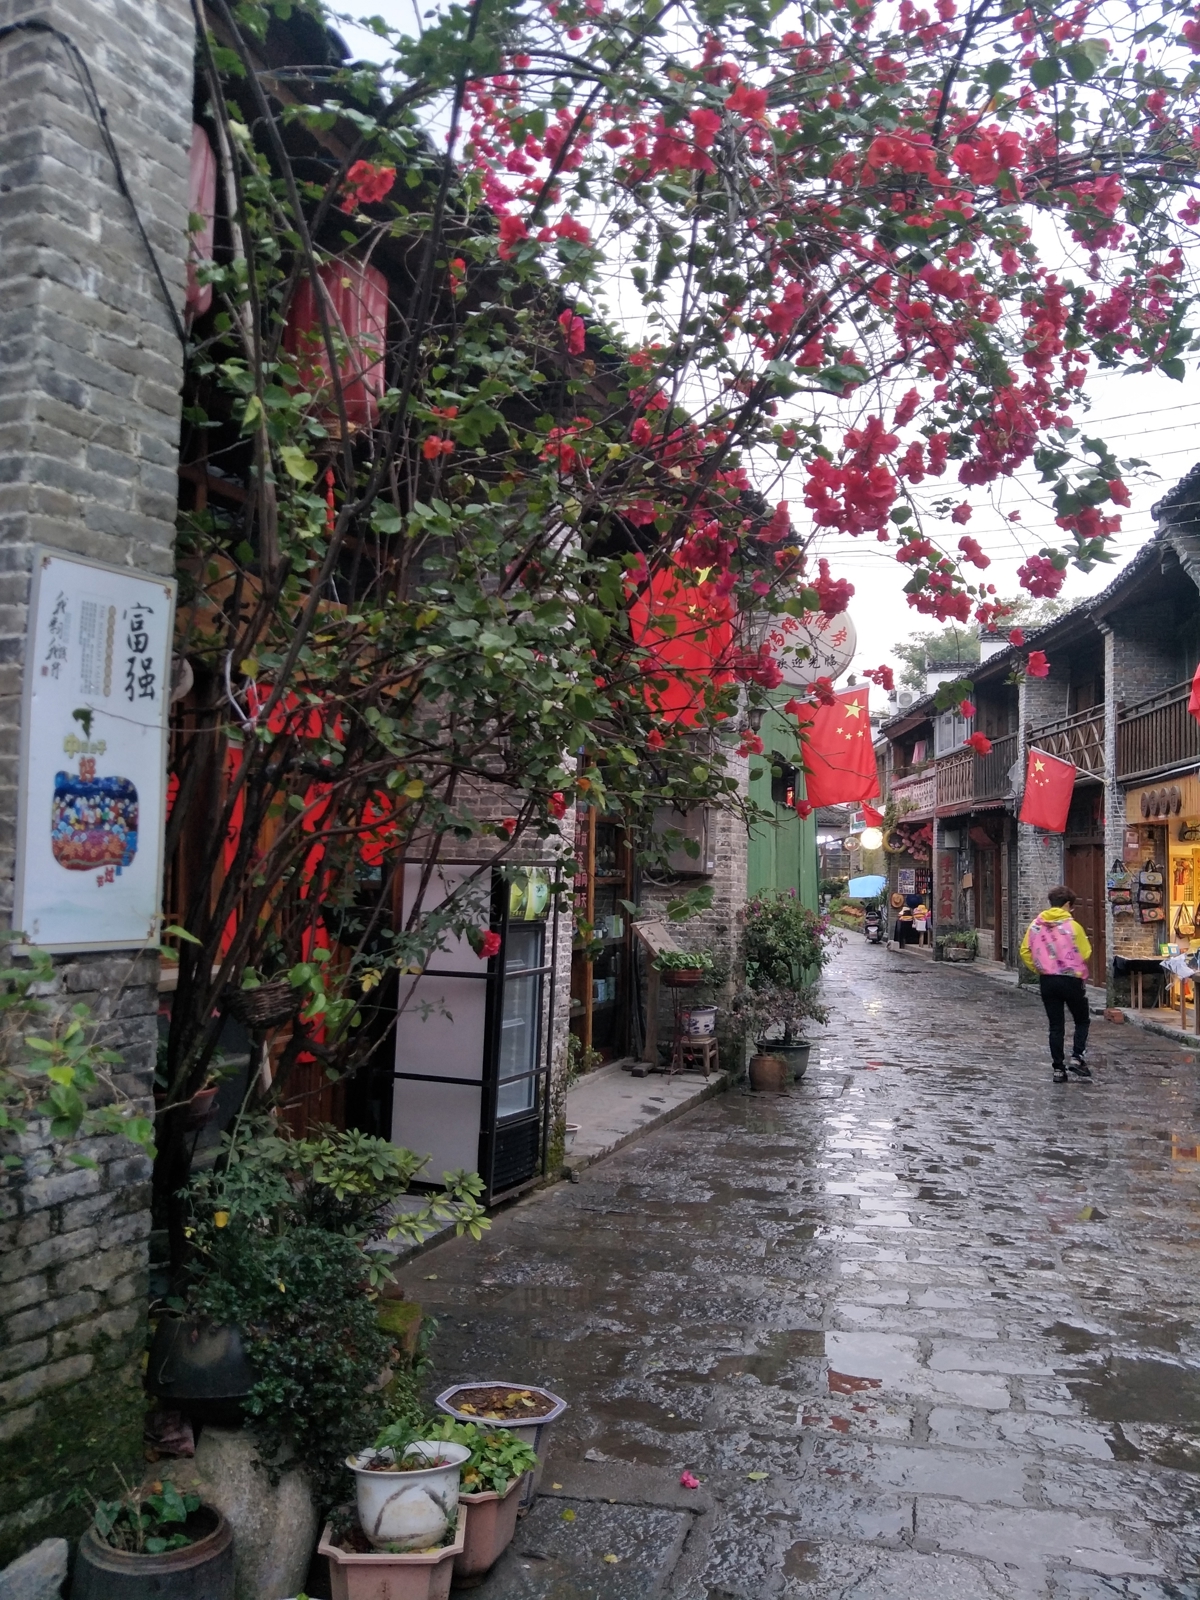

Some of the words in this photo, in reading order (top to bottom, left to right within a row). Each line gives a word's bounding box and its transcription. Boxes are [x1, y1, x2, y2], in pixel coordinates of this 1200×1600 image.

[122, 601, 156, 702] 富强
[777, 653, 838, 670] 欢迎光临
